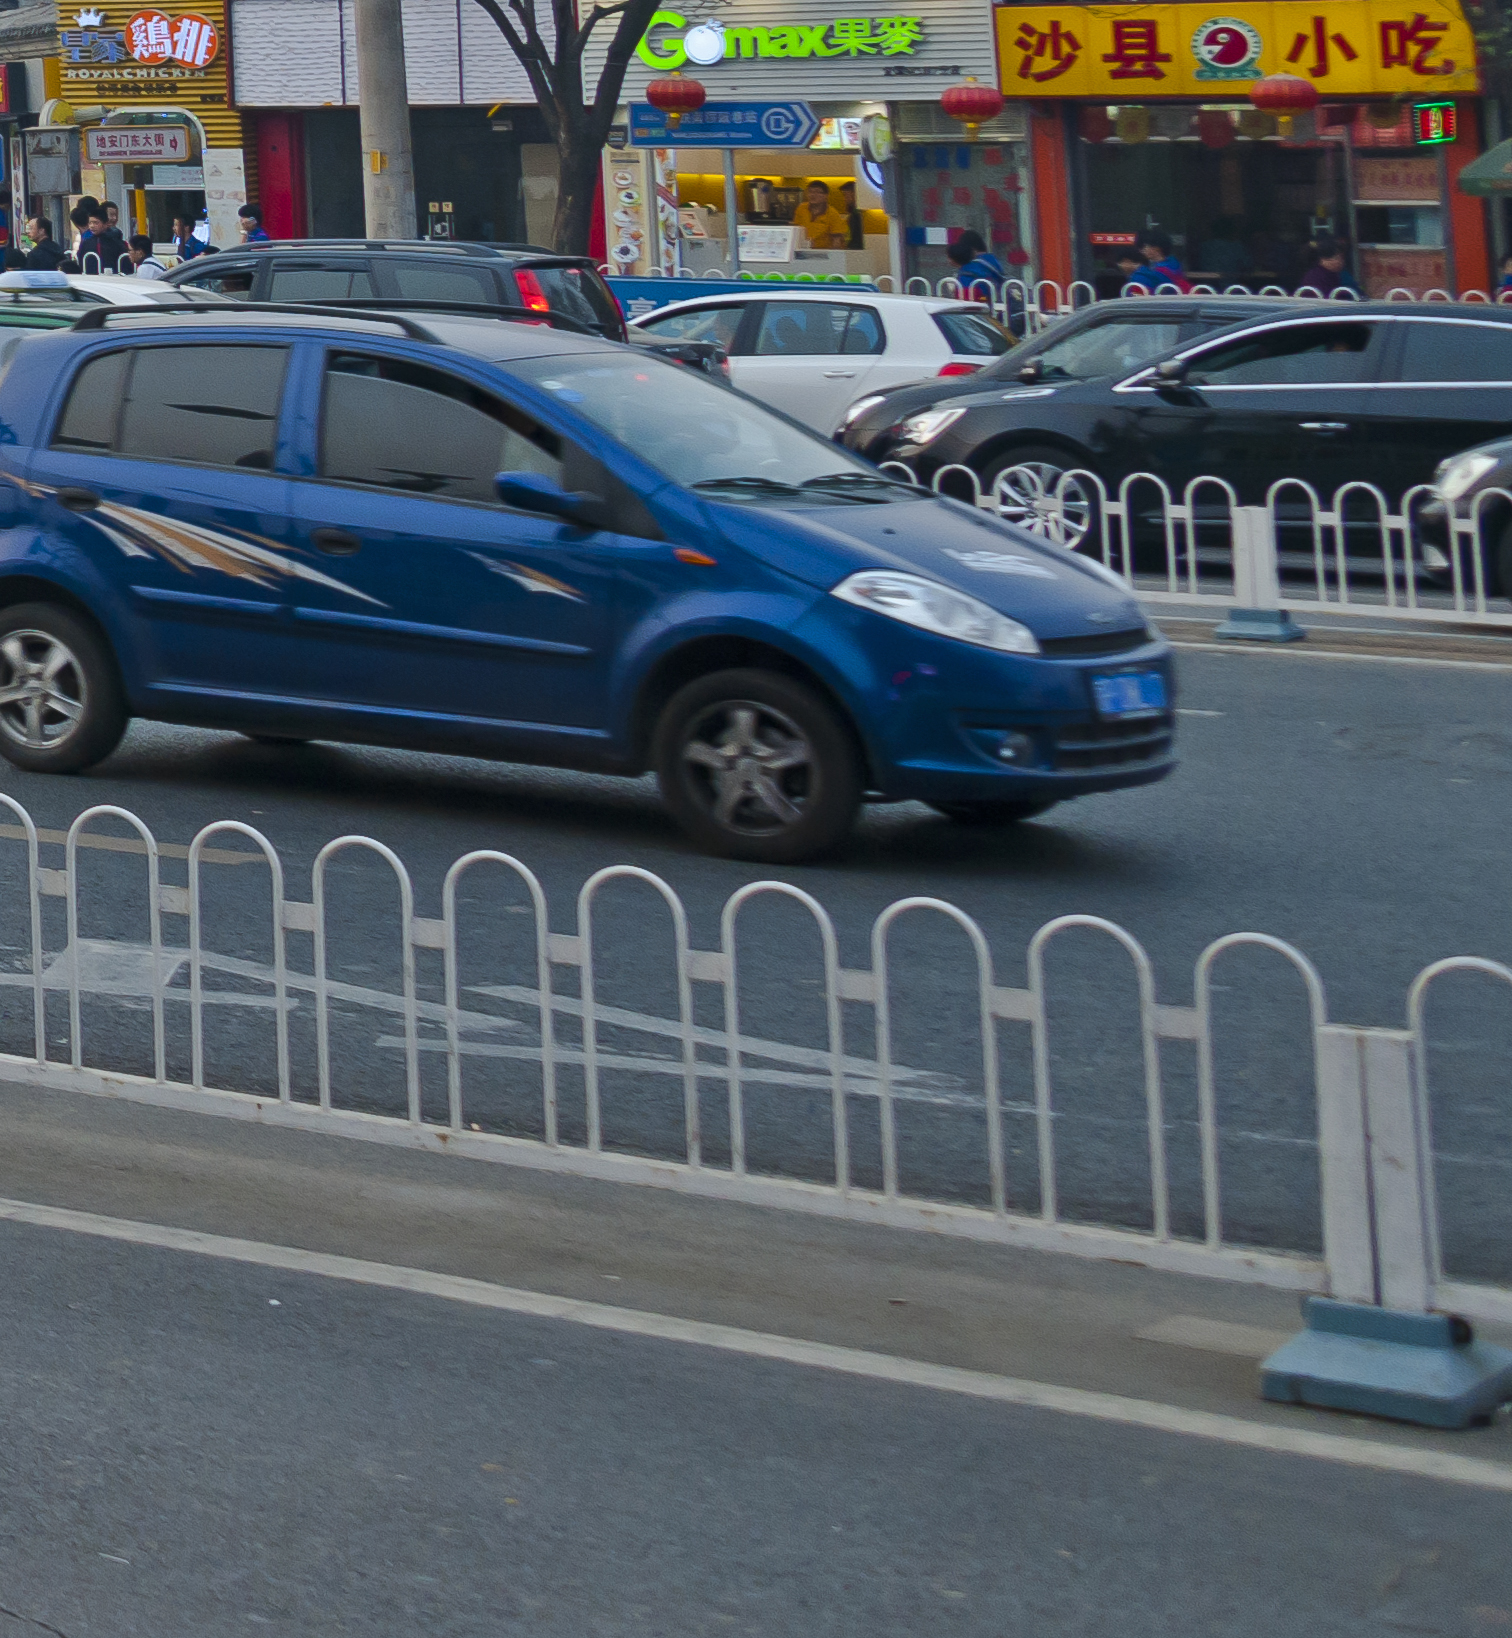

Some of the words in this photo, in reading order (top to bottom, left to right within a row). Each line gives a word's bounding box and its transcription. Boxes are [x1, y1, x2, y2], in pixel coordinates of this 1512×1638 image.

[1014, 19, 1171, 82] 沙县
[1285, 14, 1456, 78] 小吃
[96, 133, 165, 148] 地安门东大街
